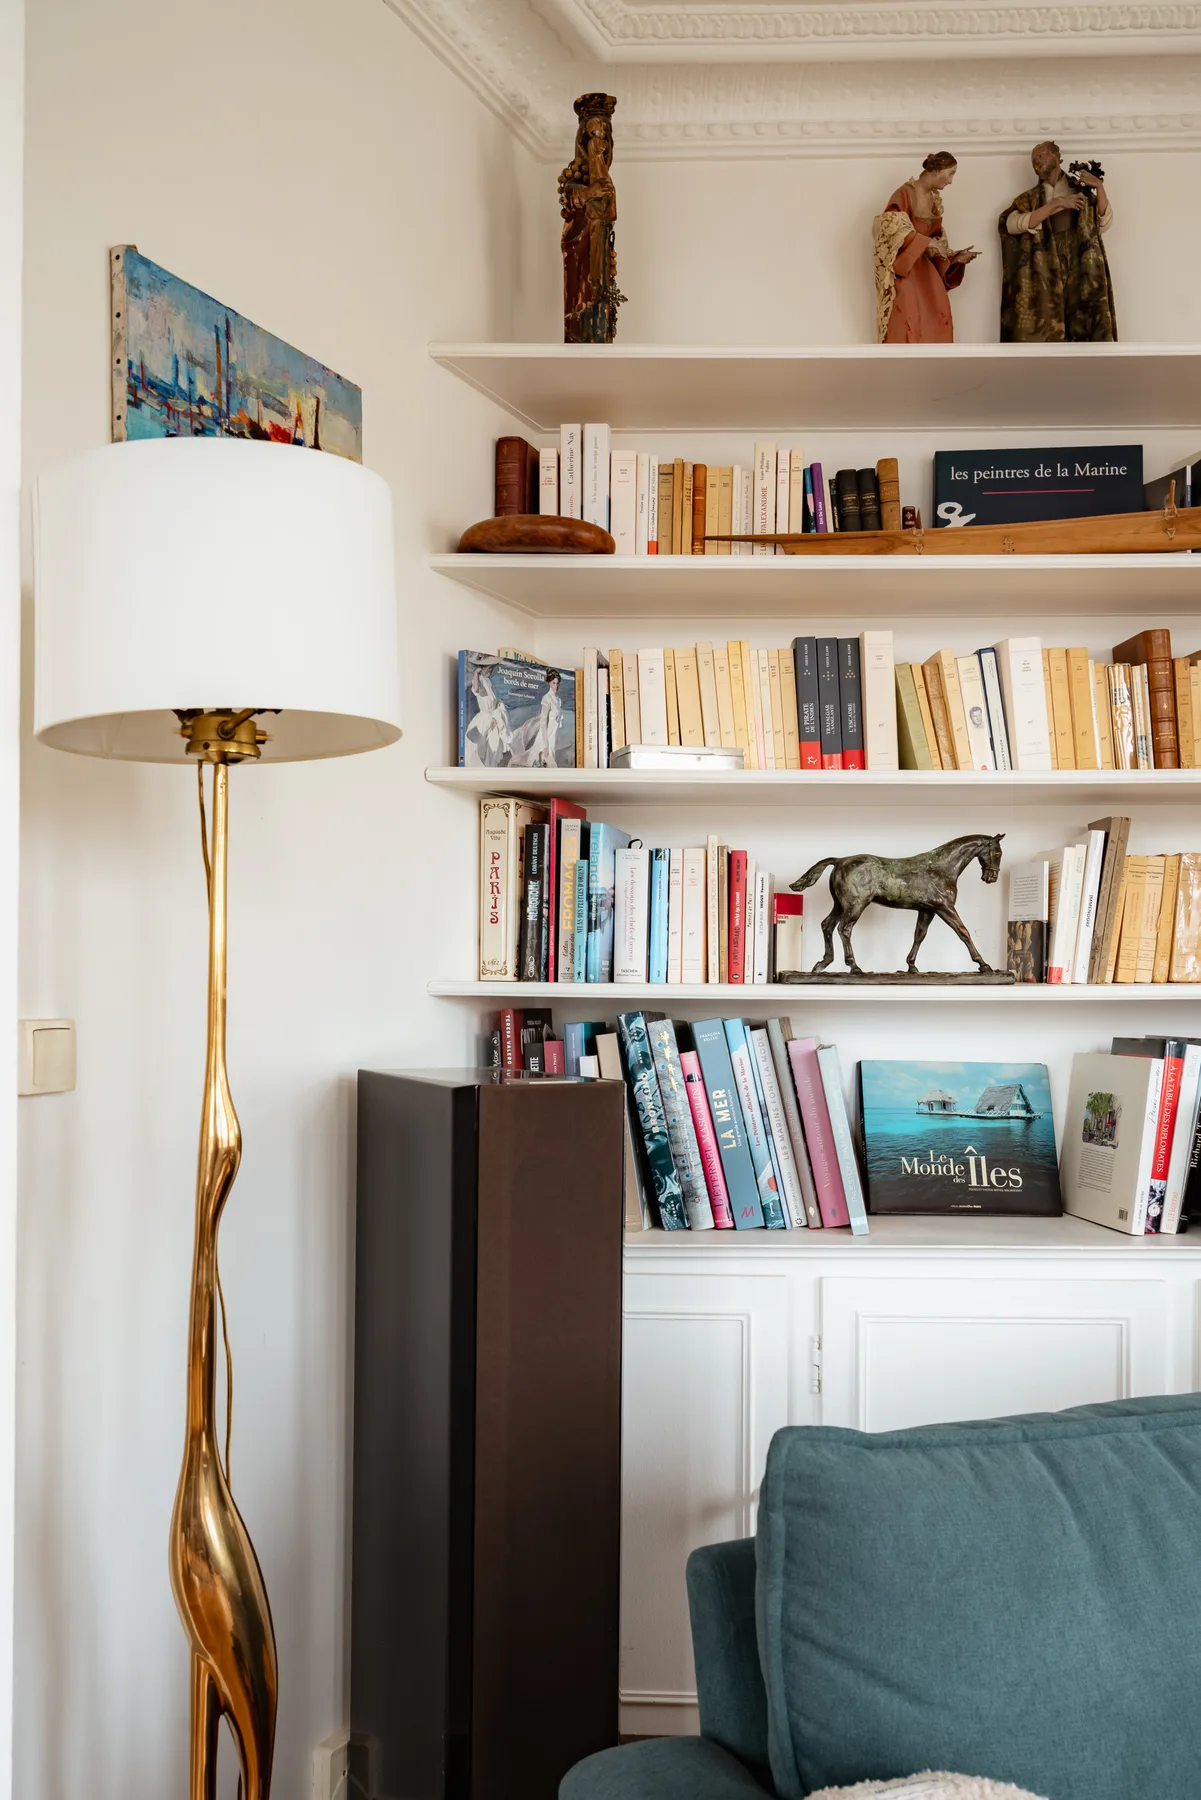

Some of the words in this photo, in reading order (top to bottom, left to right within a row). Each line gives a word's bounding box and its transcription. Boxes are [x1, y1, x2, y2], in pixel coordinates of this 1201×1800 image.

[567, 432, 576, 445] Nay
[567, 447, 575, 485] Catherine
[950, 466, 968, 481] les
[973, 465, 1030, 483] peintres
[1034, 463, 1052, 477] de
[1057, 462, 1069, 477] la
[1074, 461, 1128, 477] Marine
[498, 666, 523, 679] Joaquin
[523, 671, 545, 682] Sorolla
[503, 677, 520, 686] bords
[528, 682, 539, 690] mer
[531, 832, 539, 850] DEUTSCH
[591, 831, 600, 883] Ireland
[562, 836, 577, 931] FROMAGES
[576, 919, 584, 934] ATLAS
[756, 1036, 768, 1063] MODE
[763, 1066, 771, 1078] LA
[767, 1081, 777, 1104] FONT
[804, 1076, 816, 1104] monde
[1166, 1082, 1175, 1107] TABLE
[692, 1088, 710, 1143] MASCULIN
[712, 1088, 731, 1123] MER
[1164, 1107, 1172, 1123] DES
[773, 1107, 784, 1142] MARINS
[814, 1122, 824, 1150] autour
[720, 1129, 737, 1149] LA
[1156, 1124, 1170, 1173] DIPLOMATES
[780, 1145, 790, 1161] LES
[929, 1150, 947, 1163] Le
[820, 1153, 832, 1188] Voyages
[900, 1156, 965, 1176] Monde
[964, 1145, 1023, 1188] Îles
[952, 1175, 966, 1184] des
